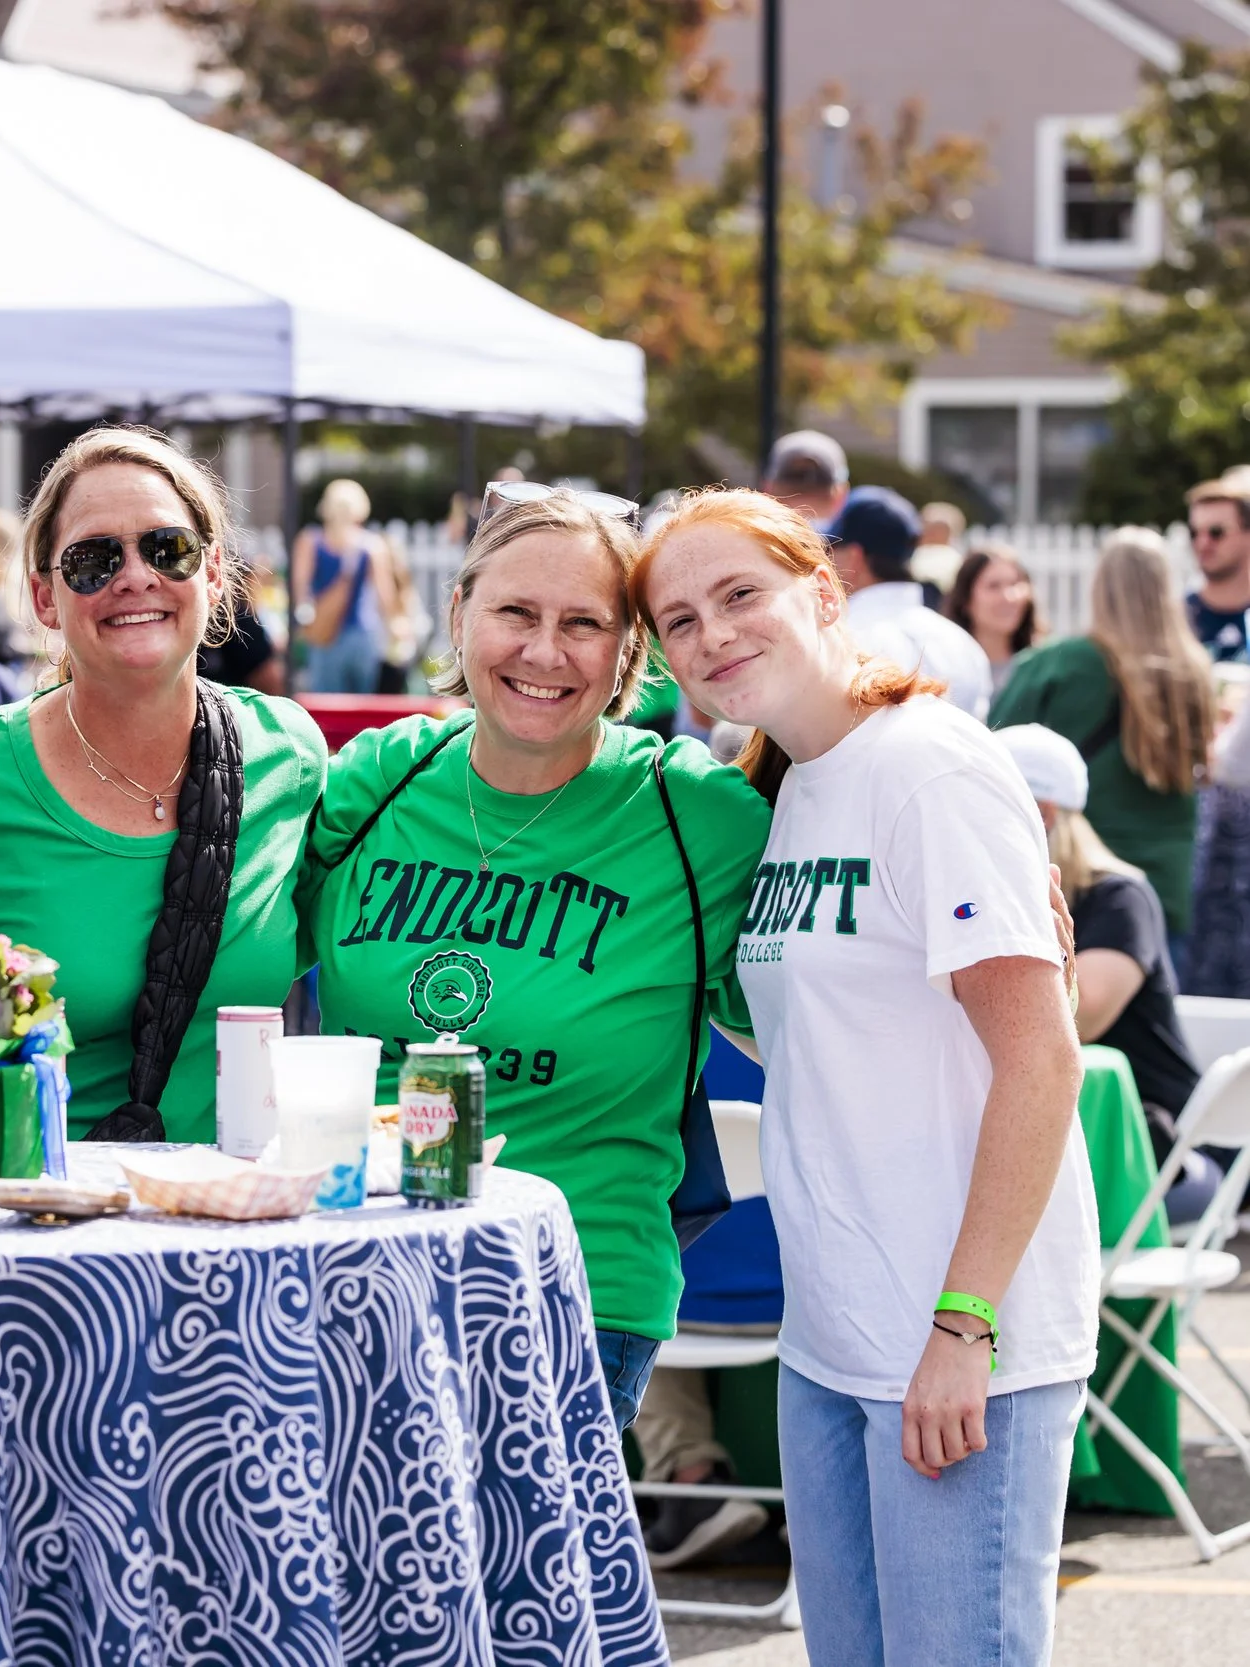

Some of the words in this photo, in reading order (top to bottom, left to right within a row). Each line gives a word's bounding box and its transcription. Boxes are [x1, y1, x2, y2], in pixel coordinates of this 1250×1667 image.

[337, 858, 631, 976] ENDICOTT
[416, 957, 458, 993] ENDICOTT
[461, 959, 486, 1000] COLLEGE
[405, 1121, 436, 1135] DRY
